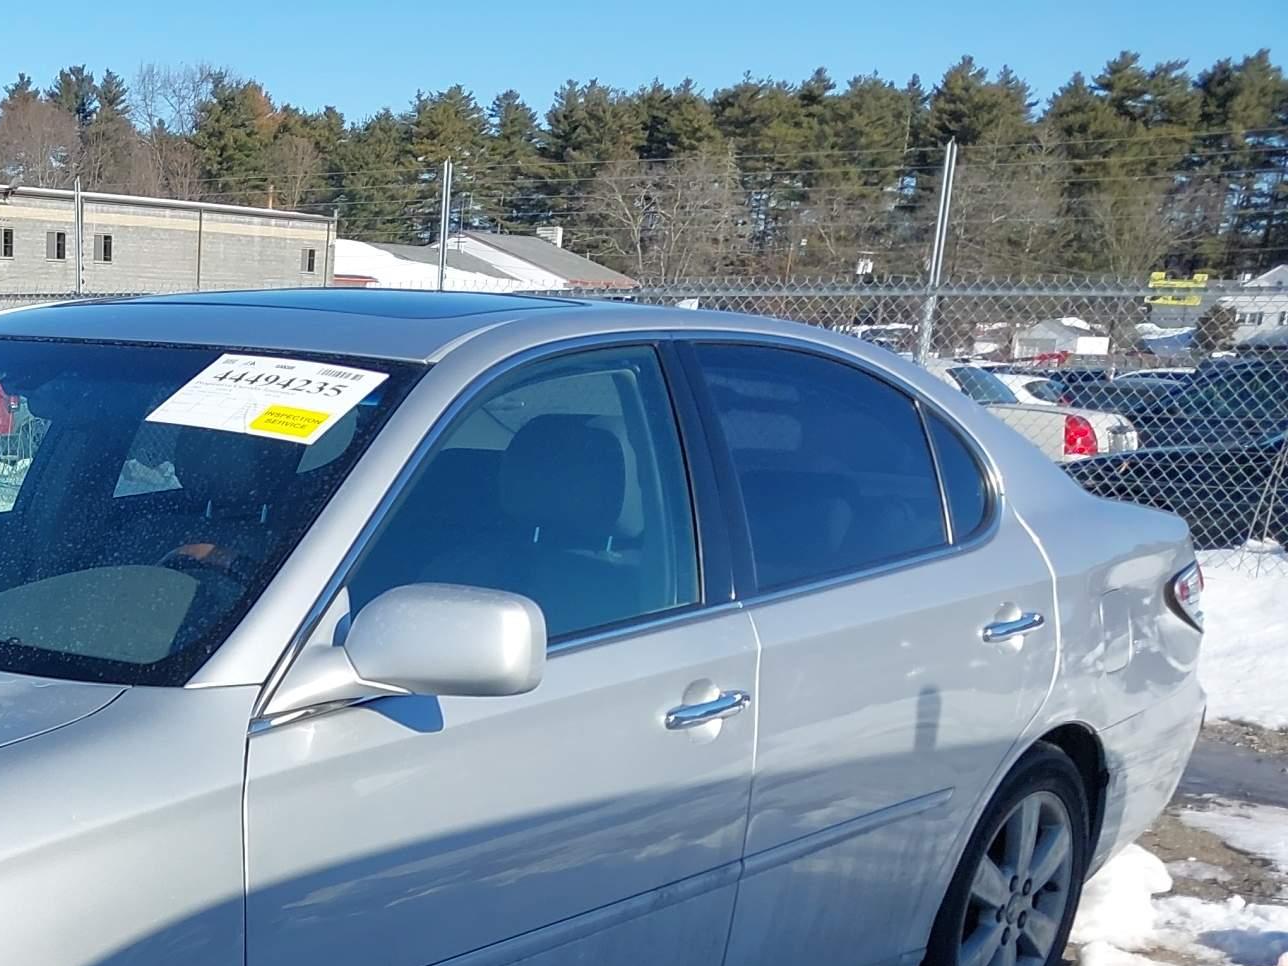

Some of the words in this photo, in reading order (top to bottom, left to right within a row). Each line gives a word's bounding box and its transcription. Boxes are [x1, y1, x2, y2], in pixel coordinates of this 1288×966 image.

[213, 369, 349, 398] 44494235
[264, 411, 322, 425] INSPECTION
[264, 418, 308, 429] SERVICE
